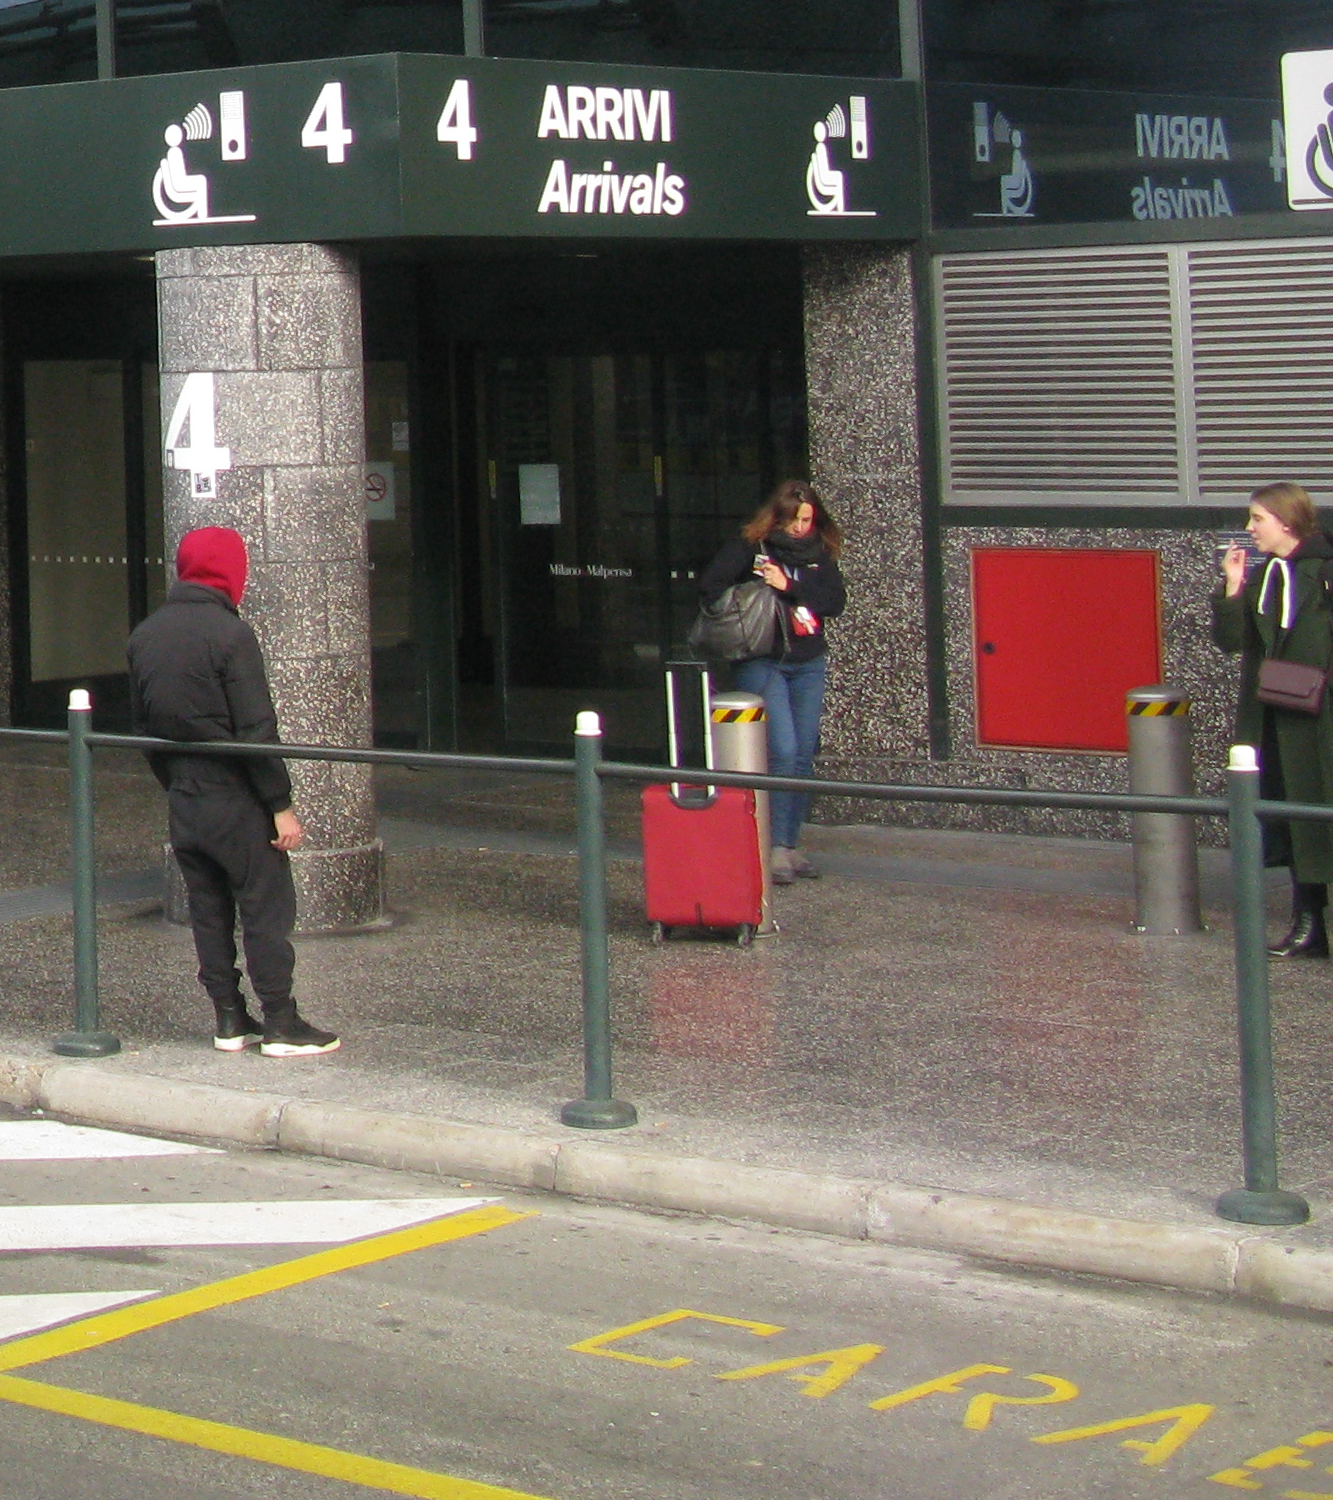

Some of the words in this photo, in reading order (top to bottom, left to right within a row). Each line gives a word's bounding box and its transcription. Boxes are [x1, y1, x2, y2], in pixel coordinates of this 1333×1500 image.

[301, 82, 353, 164] 4
[436, 79, 478, 161] 4
[537, 84, 672, 142] ARRIVI
[537, 159, 685, 216] Arrivals
[164, 372, 231, 498] 4
[549, 563, 582, 576] Milano
[586, 563, 633, 580] Malpensa
